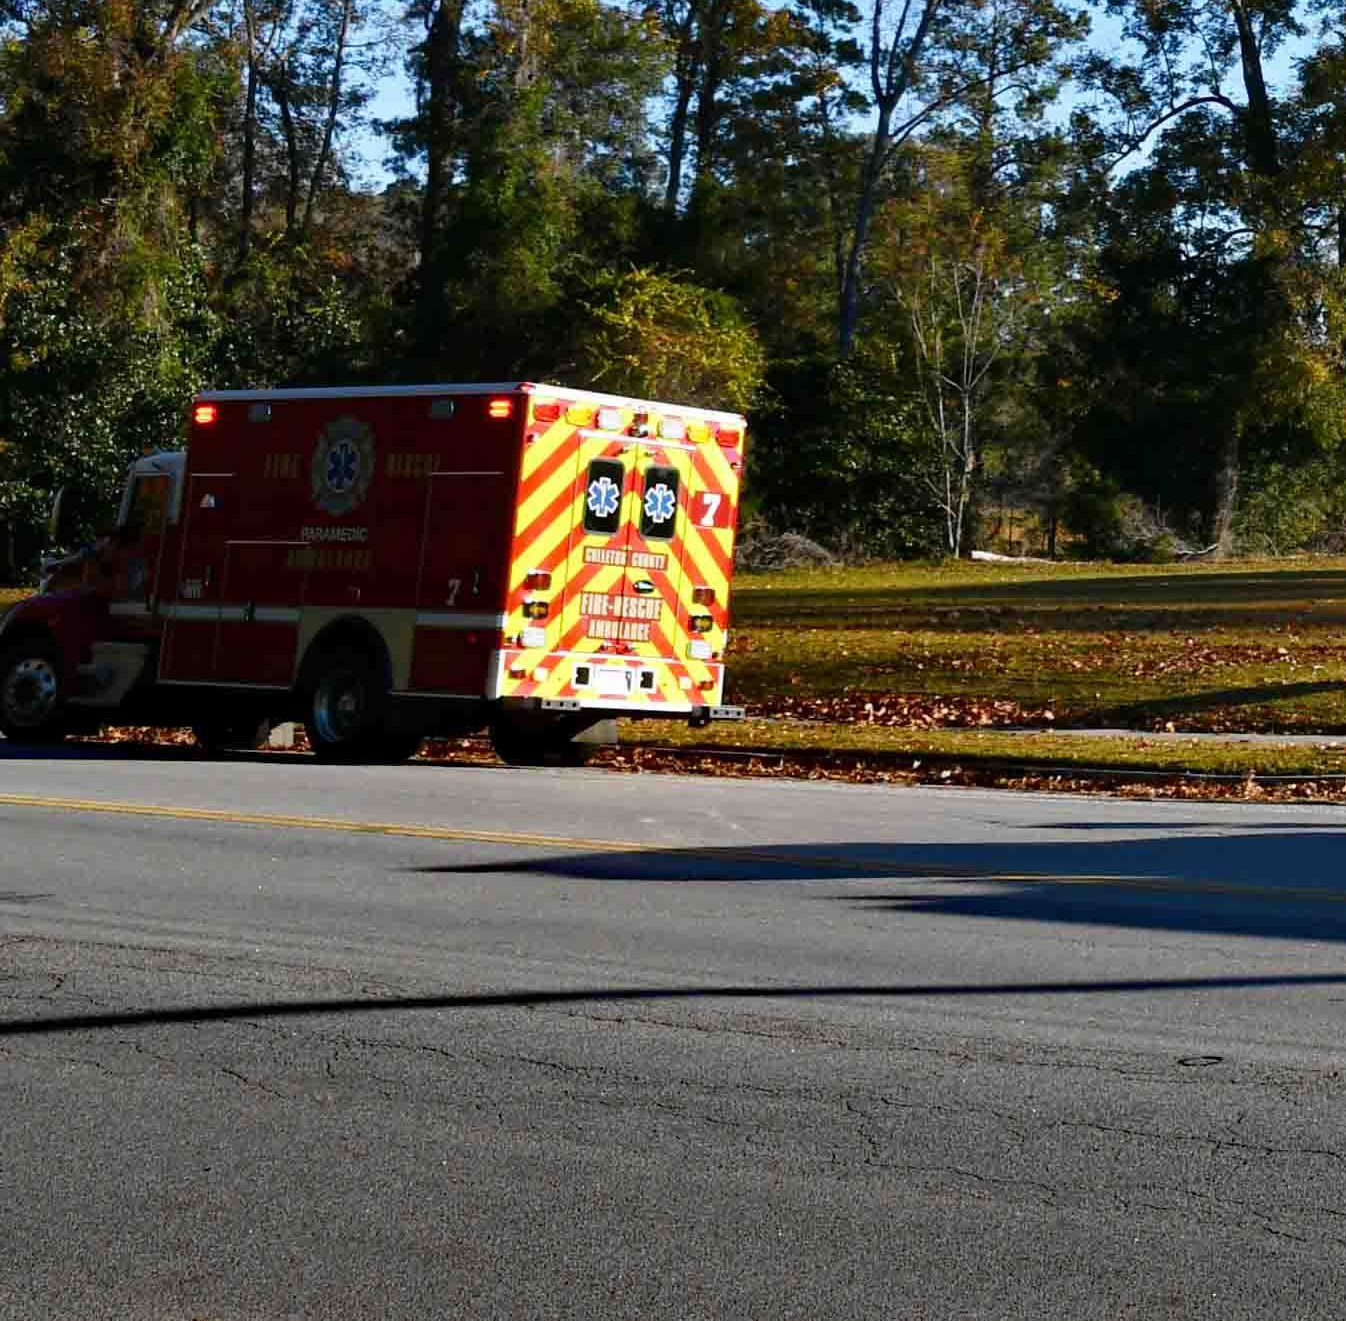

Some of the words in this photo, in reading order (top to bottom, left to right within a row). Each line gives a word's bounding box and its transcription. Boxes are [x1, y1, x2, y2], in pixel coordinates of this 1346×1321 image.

[700, 493, 722, 527] 7
[445, 578, 464, 607] 7
[582, 593, 662, 619] FIRE-RESCUE
[588, 619, 650, 643] AMBULANCE
